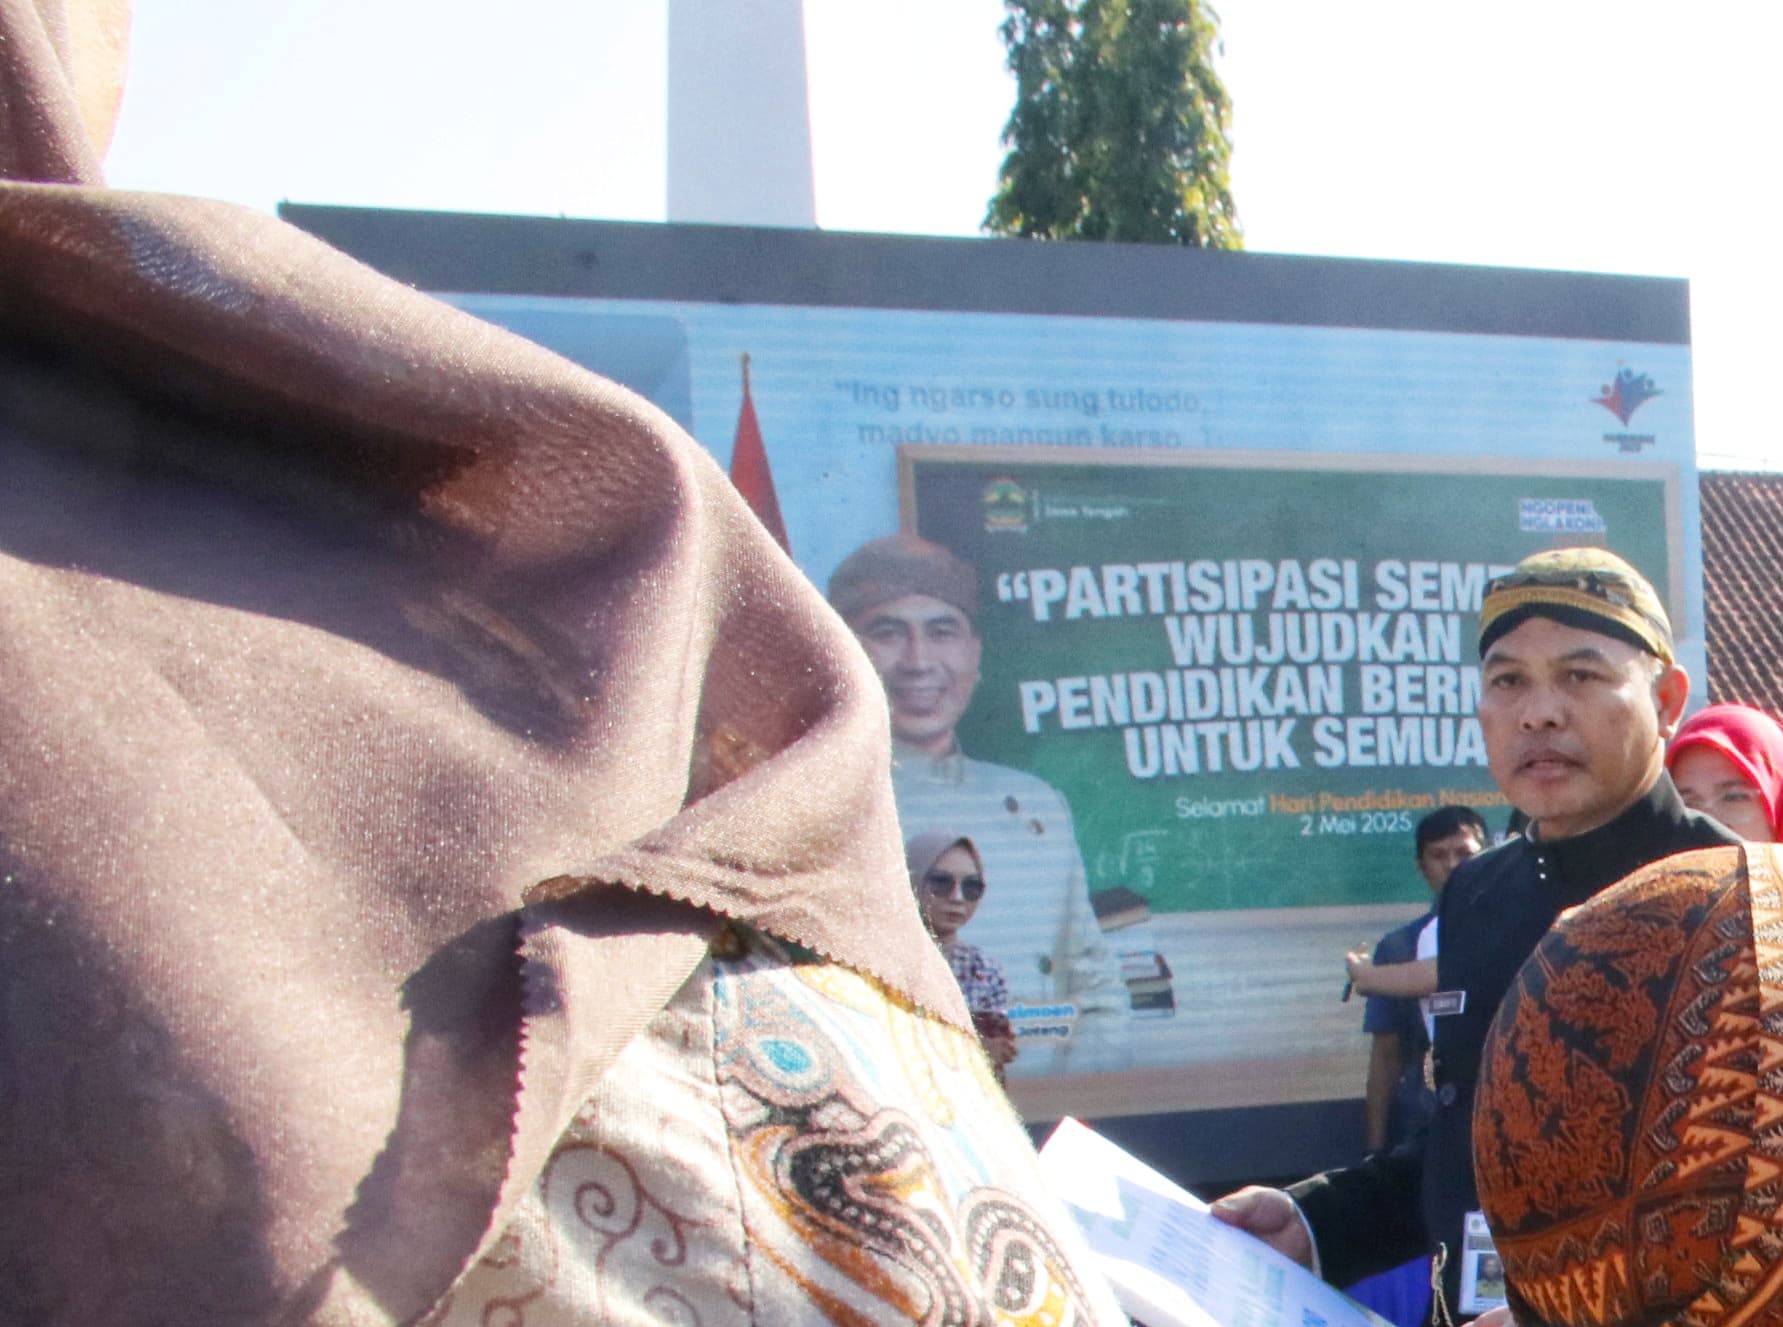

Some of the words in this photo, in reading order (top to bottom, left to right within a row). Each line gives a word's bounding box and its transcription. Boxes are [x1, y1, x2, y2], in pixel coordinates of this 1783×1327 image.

[910, 385, 1016, 412] ngarso
[1026, 388, 1101, 416] sung
[1164, 613, 1461, 666] WUJUDKAN
[1019, 664, 1338, 733] PENDIDIKAN
[1124, 719, 1299, 780] UNTUK
[1313, 716, 1489, 768] SEMUA
[1175, 793, 1265, 819] Selamat
[1269, 793, 1313, 813] Hari
[1319, 789, 1434, 812] Pendidikan
[1300, 815, 1315, 836] 2
[1319, 815, 1357, 834] Mei
[1362, 811, 1413, 832] 2025
